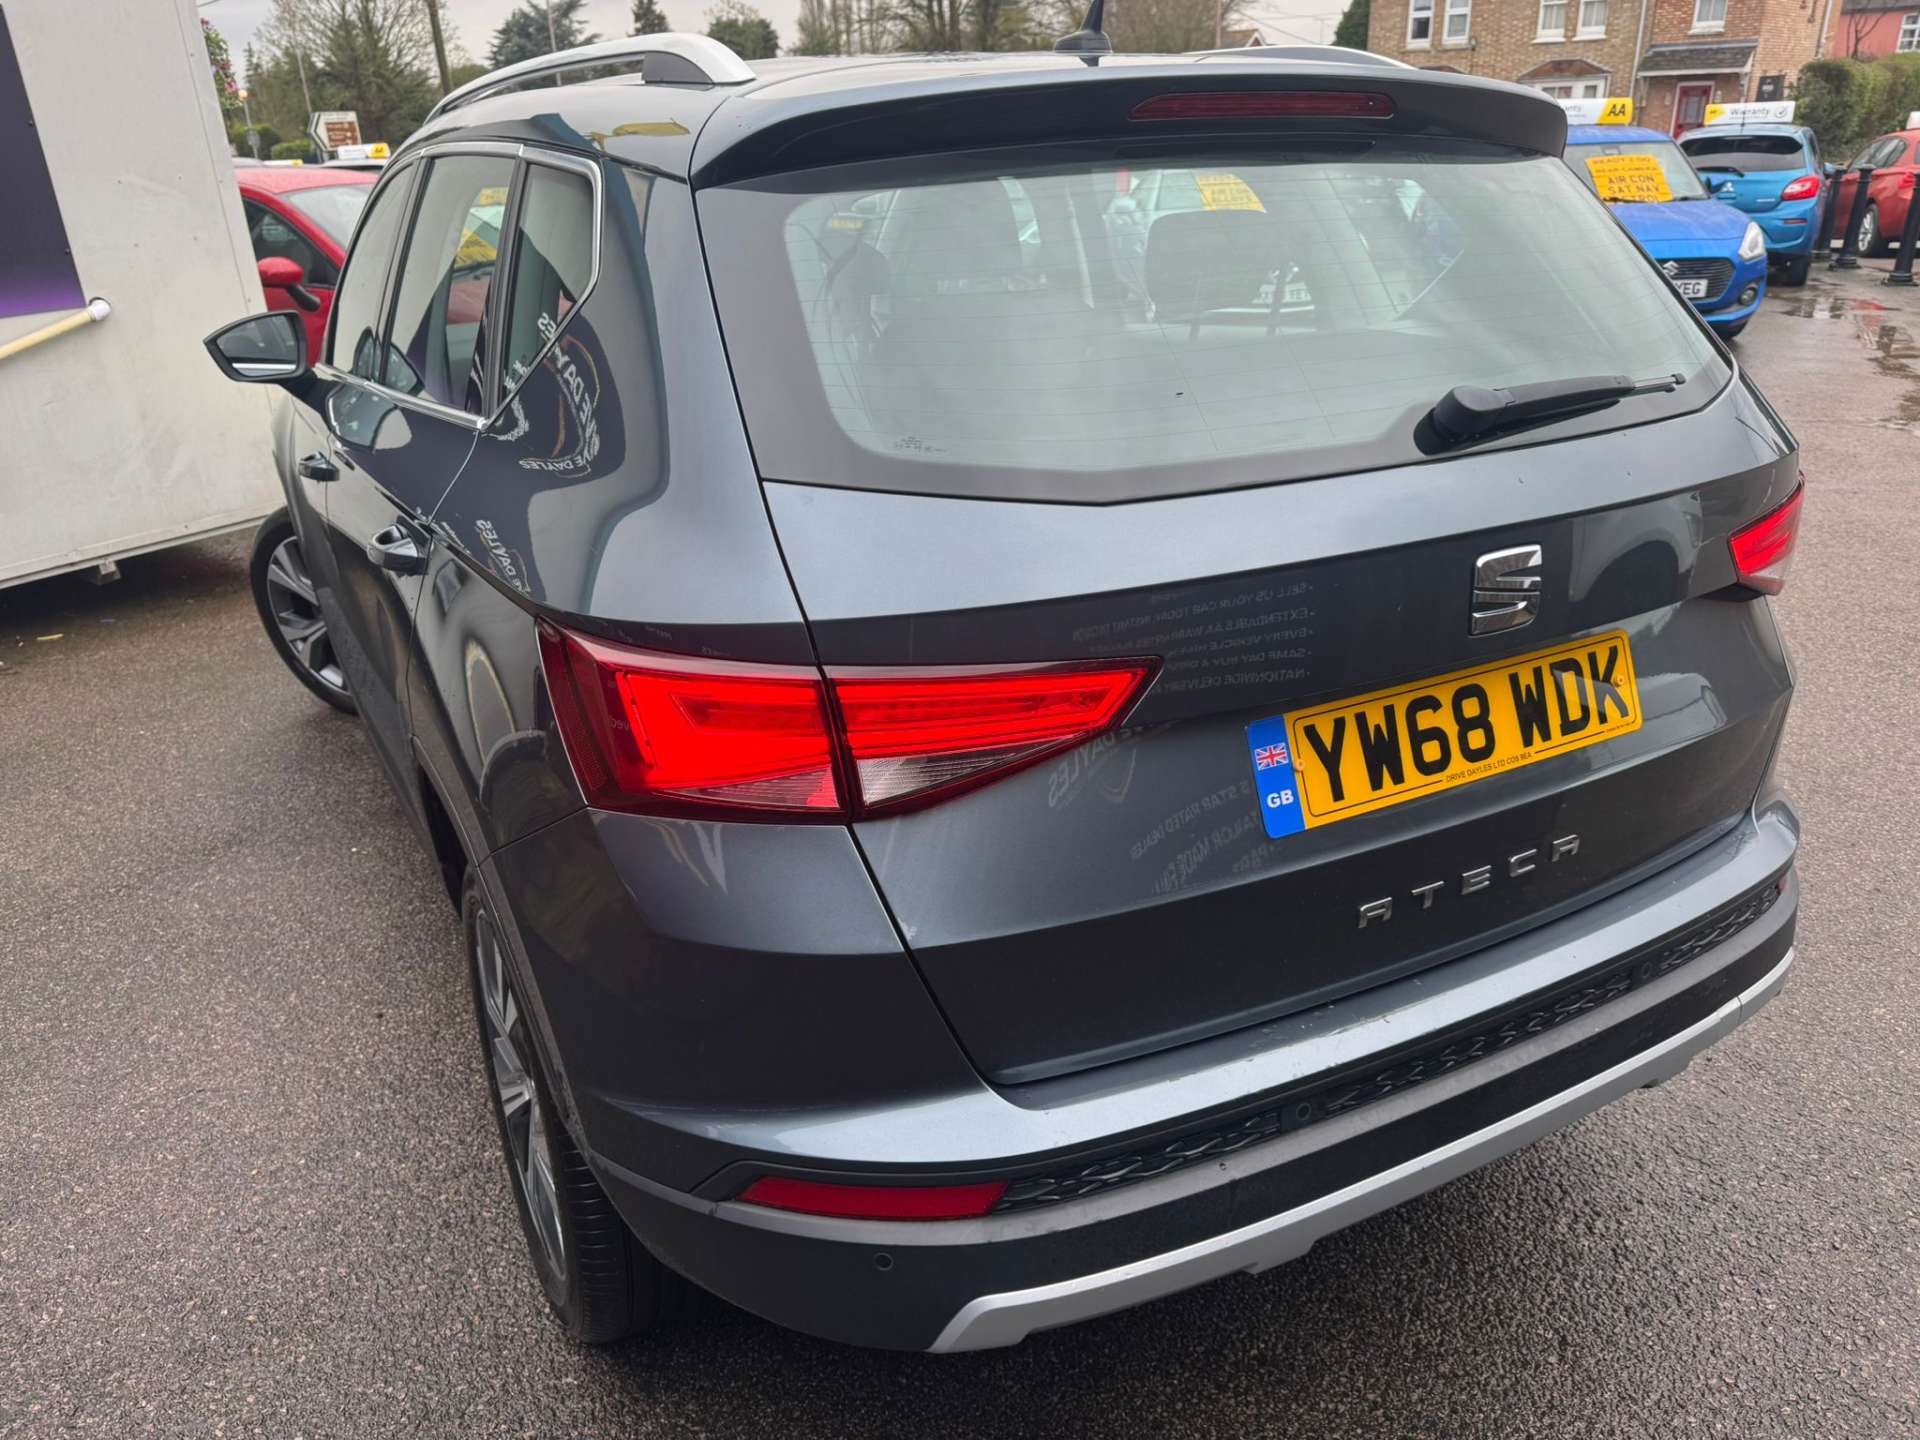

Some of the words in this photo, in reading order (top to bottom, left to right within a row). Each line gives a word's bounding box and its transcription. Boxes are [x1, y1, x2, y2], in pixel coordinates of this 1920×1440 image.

[1607, 103, 1626, 117] AA
[1608, 185, 1632, 194] SAT
[1636, 184, 1660, 193] NAV
[1629, 174, 1656, 184] CON
[1303, 682, 1497, 803] YW68
[1508, 645, 1630, 748] WDK
[1446, 770, 1467, 783] DRIVE
[1466, 763, 1493, 777] DAYLES
[1266, 788, 1295, 809] GB
[1358, 833, 1580, 929] ATECA
